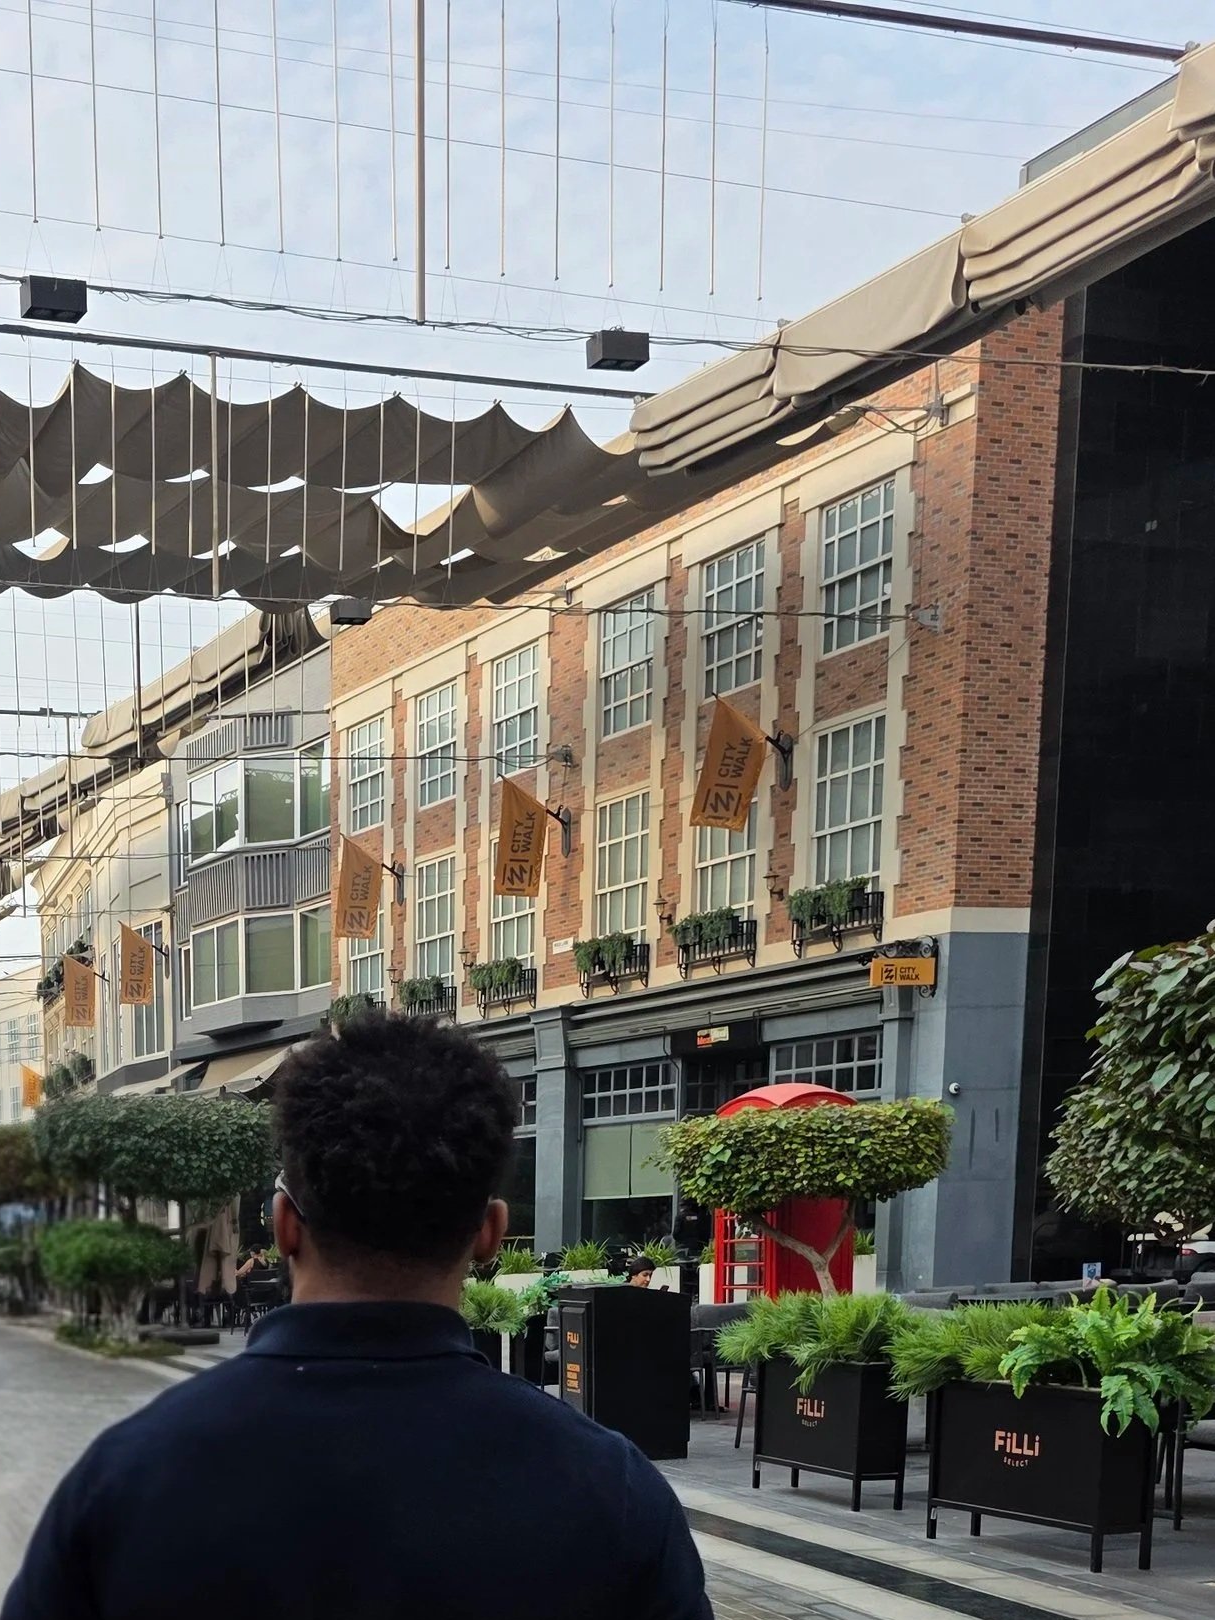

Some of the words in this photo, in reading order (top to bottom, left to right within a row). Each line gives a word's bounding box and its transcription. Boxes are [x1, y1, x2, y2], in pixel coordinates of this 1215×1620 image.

[718, 742, 737, 778] CITY
[730, 737, 754, 779] WALK
[511, 820, 524, 853] CITY
[521, 812, 536, 853] WALK
[350, 872, 362, 900] CITY
[359, 865, 373, 900] WALK
[130, 952, 138, 975] CITY
[137, 946, 146, 975] WALK
[1004, 1456, 1029, 1468] SELECT
